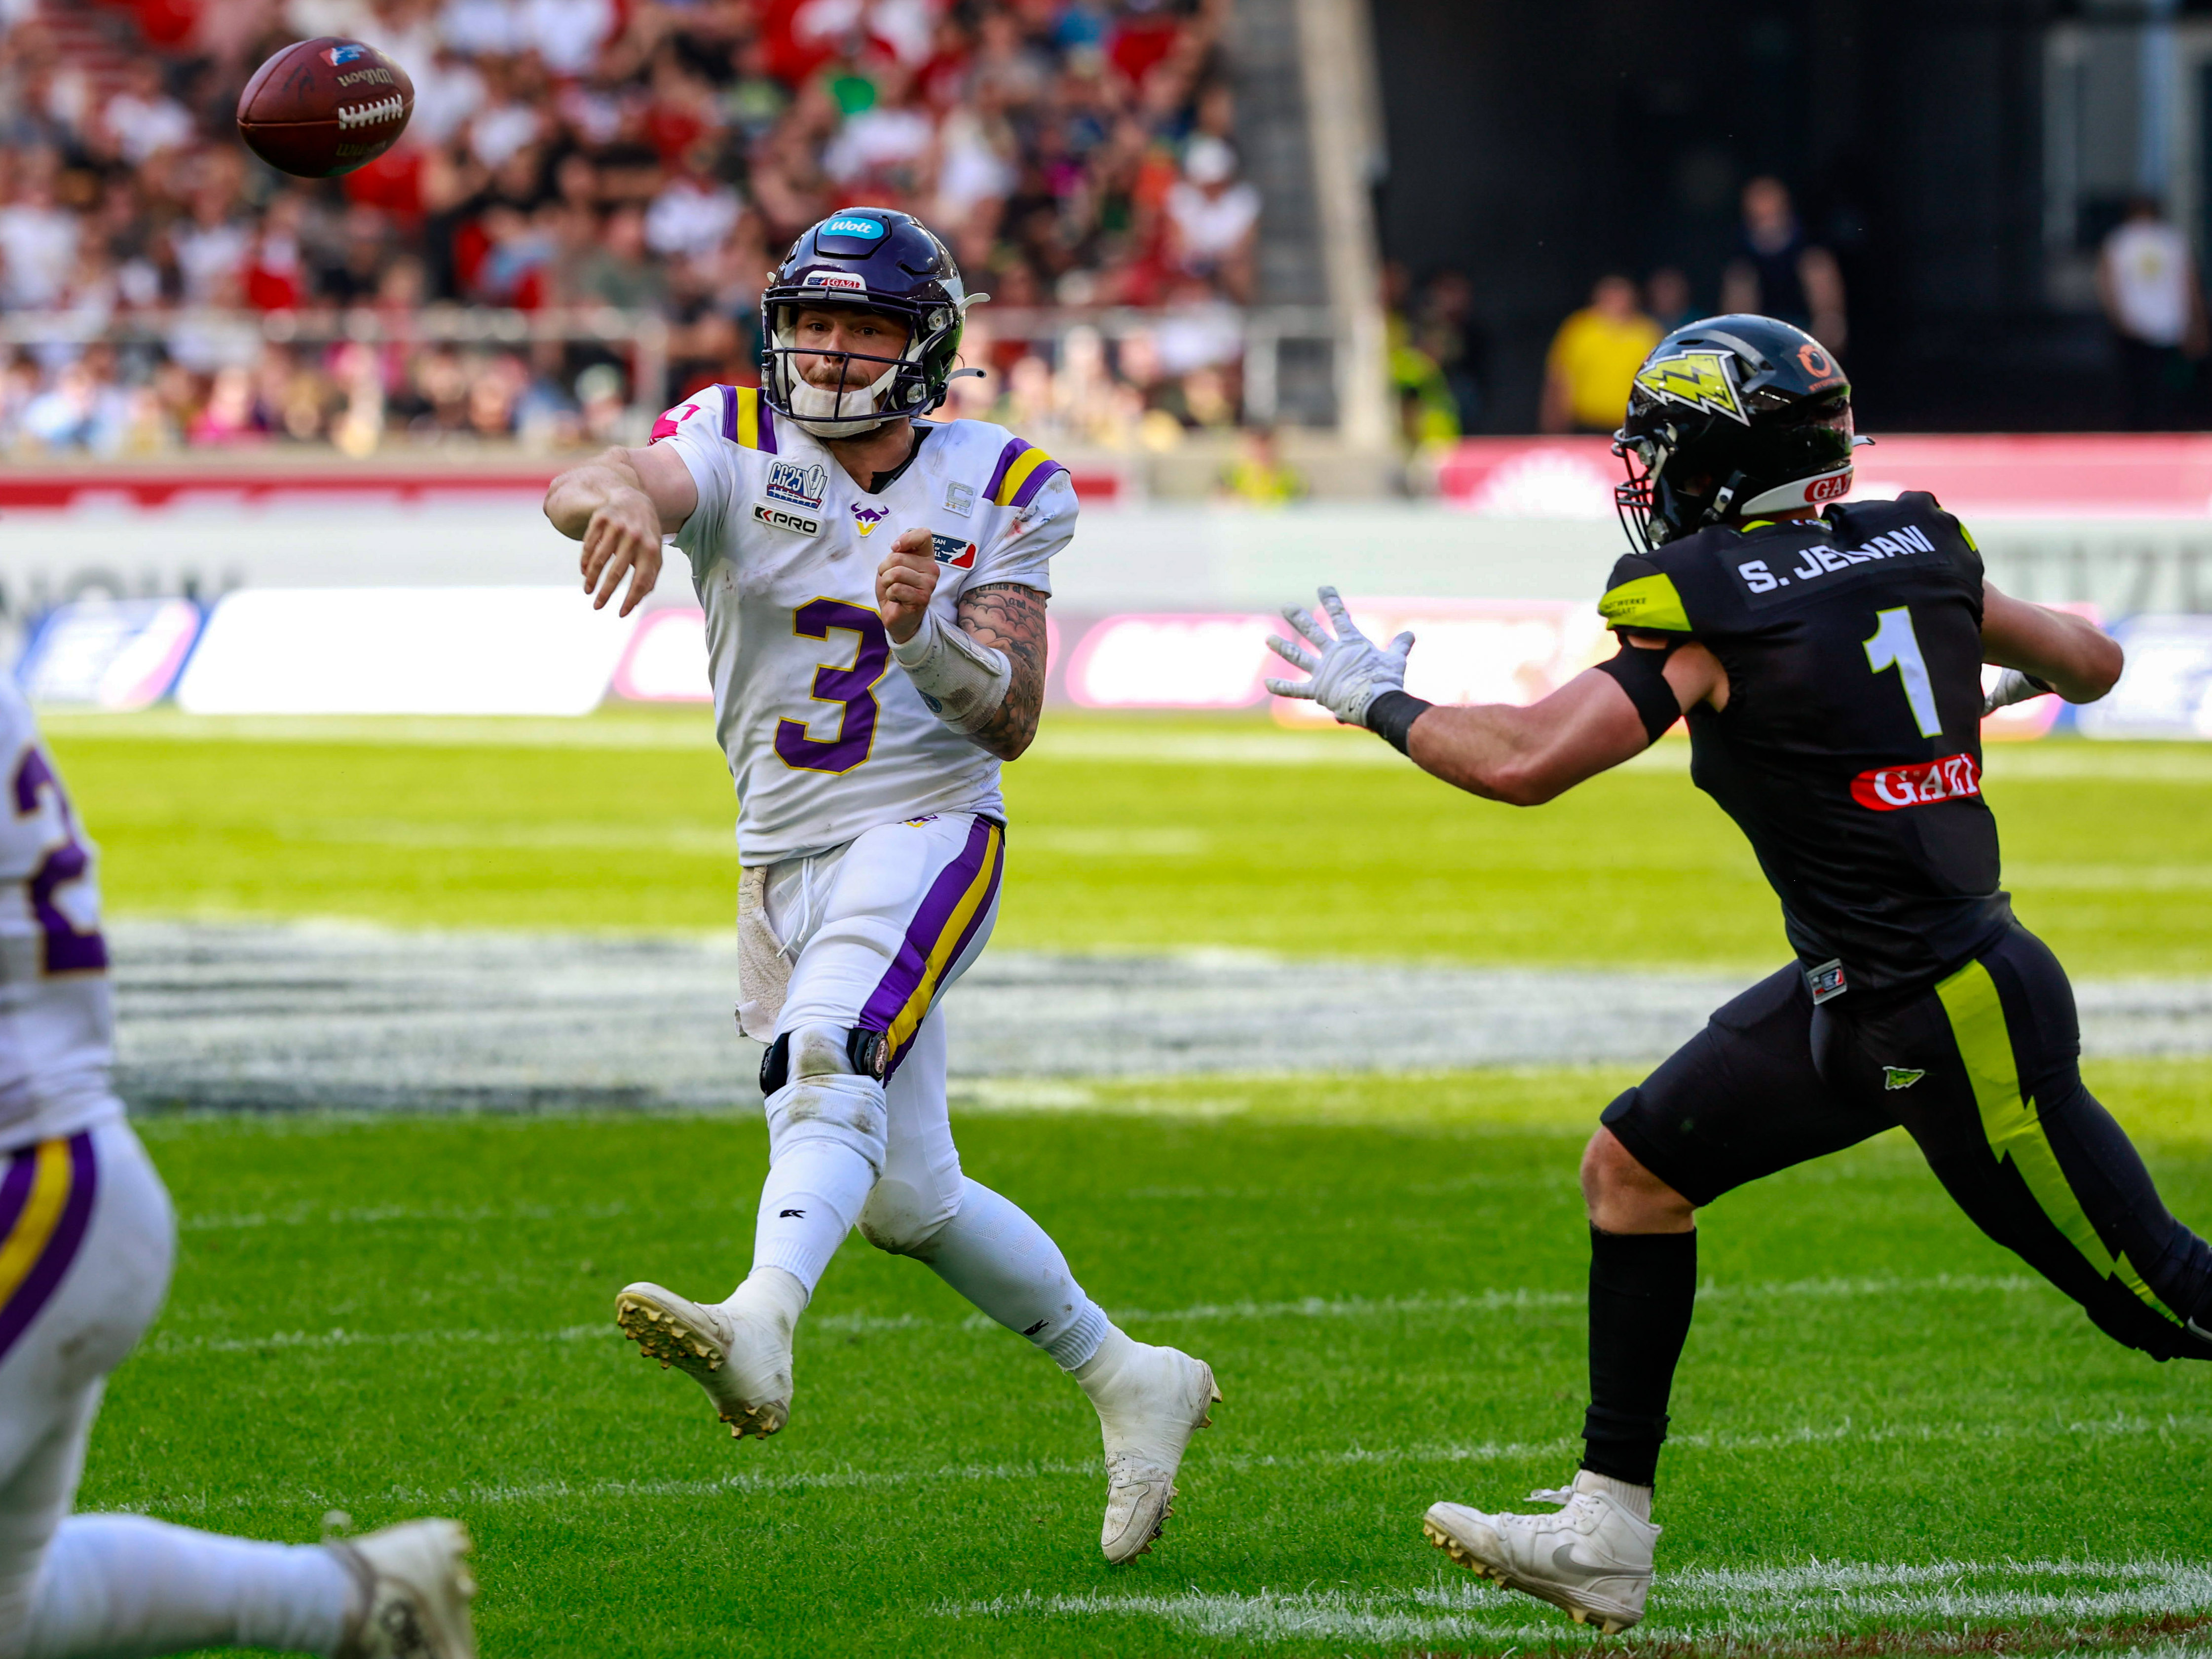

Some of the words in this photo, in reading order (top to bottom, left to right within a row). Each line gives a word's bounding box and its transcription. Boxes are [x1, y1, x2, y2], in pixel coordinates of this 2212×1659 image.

[337, 68, 394, 87] Wilson
[830, 220, 872, 233] Wolt
[832, 279, 857, 288] GAZI
[769, 462, 803, 492] CG25
[947, 483, 974, 508] C
[1738, 560, 1791, 594] S.
[773, 596, 892, 777] 3
[1862, 605, 1943, 739] 1
[1875, 753, 1978, 806] GAZI
